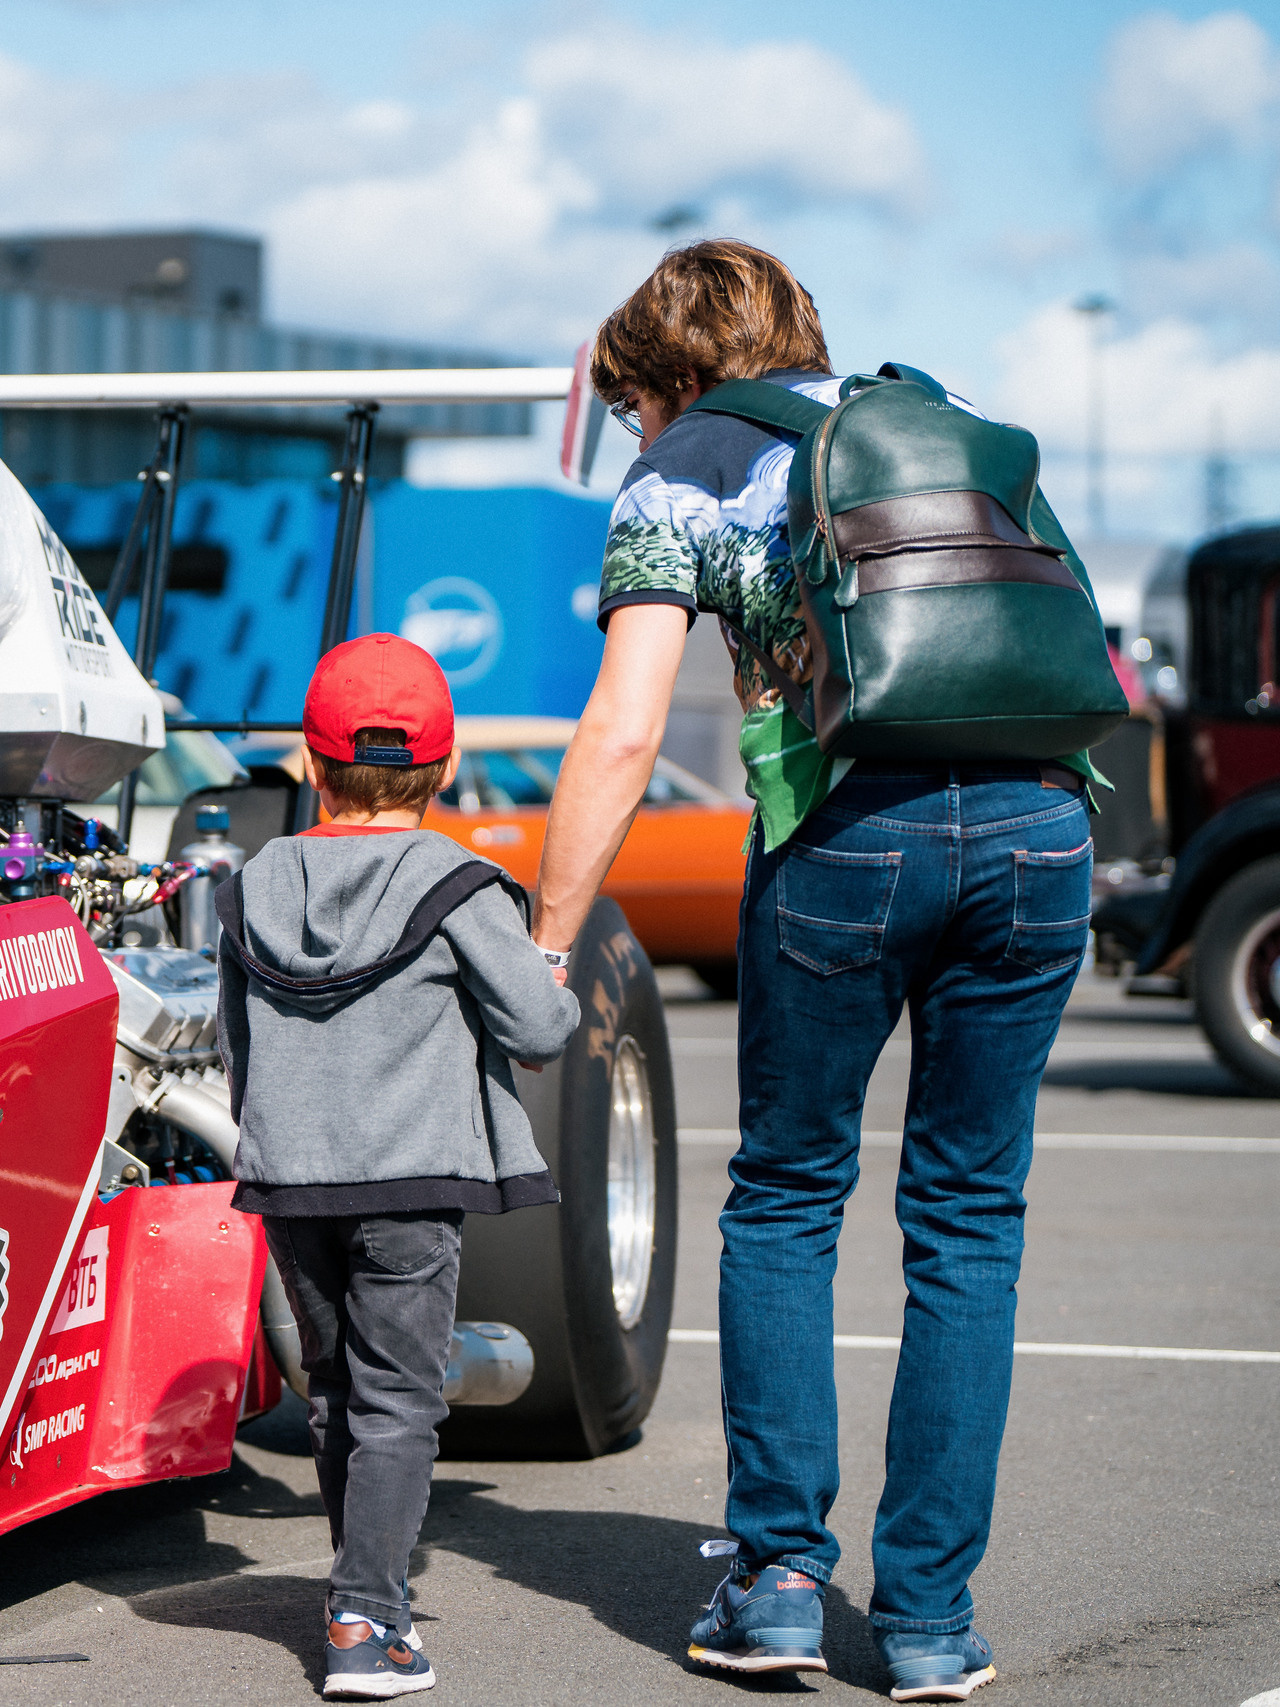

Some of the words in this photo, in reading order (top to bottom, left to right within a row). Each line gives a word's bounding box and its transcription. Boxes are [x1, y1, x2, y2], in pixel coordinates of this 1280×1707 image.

[51, 576, 107, 647] RIDE
[67, 1254, 98, 1314] ВТБ
[24, 1419, 47, 1454] SMP
[47, 1403, 86, 1445] RACING
[777, 1580, 816, 1591] balance
